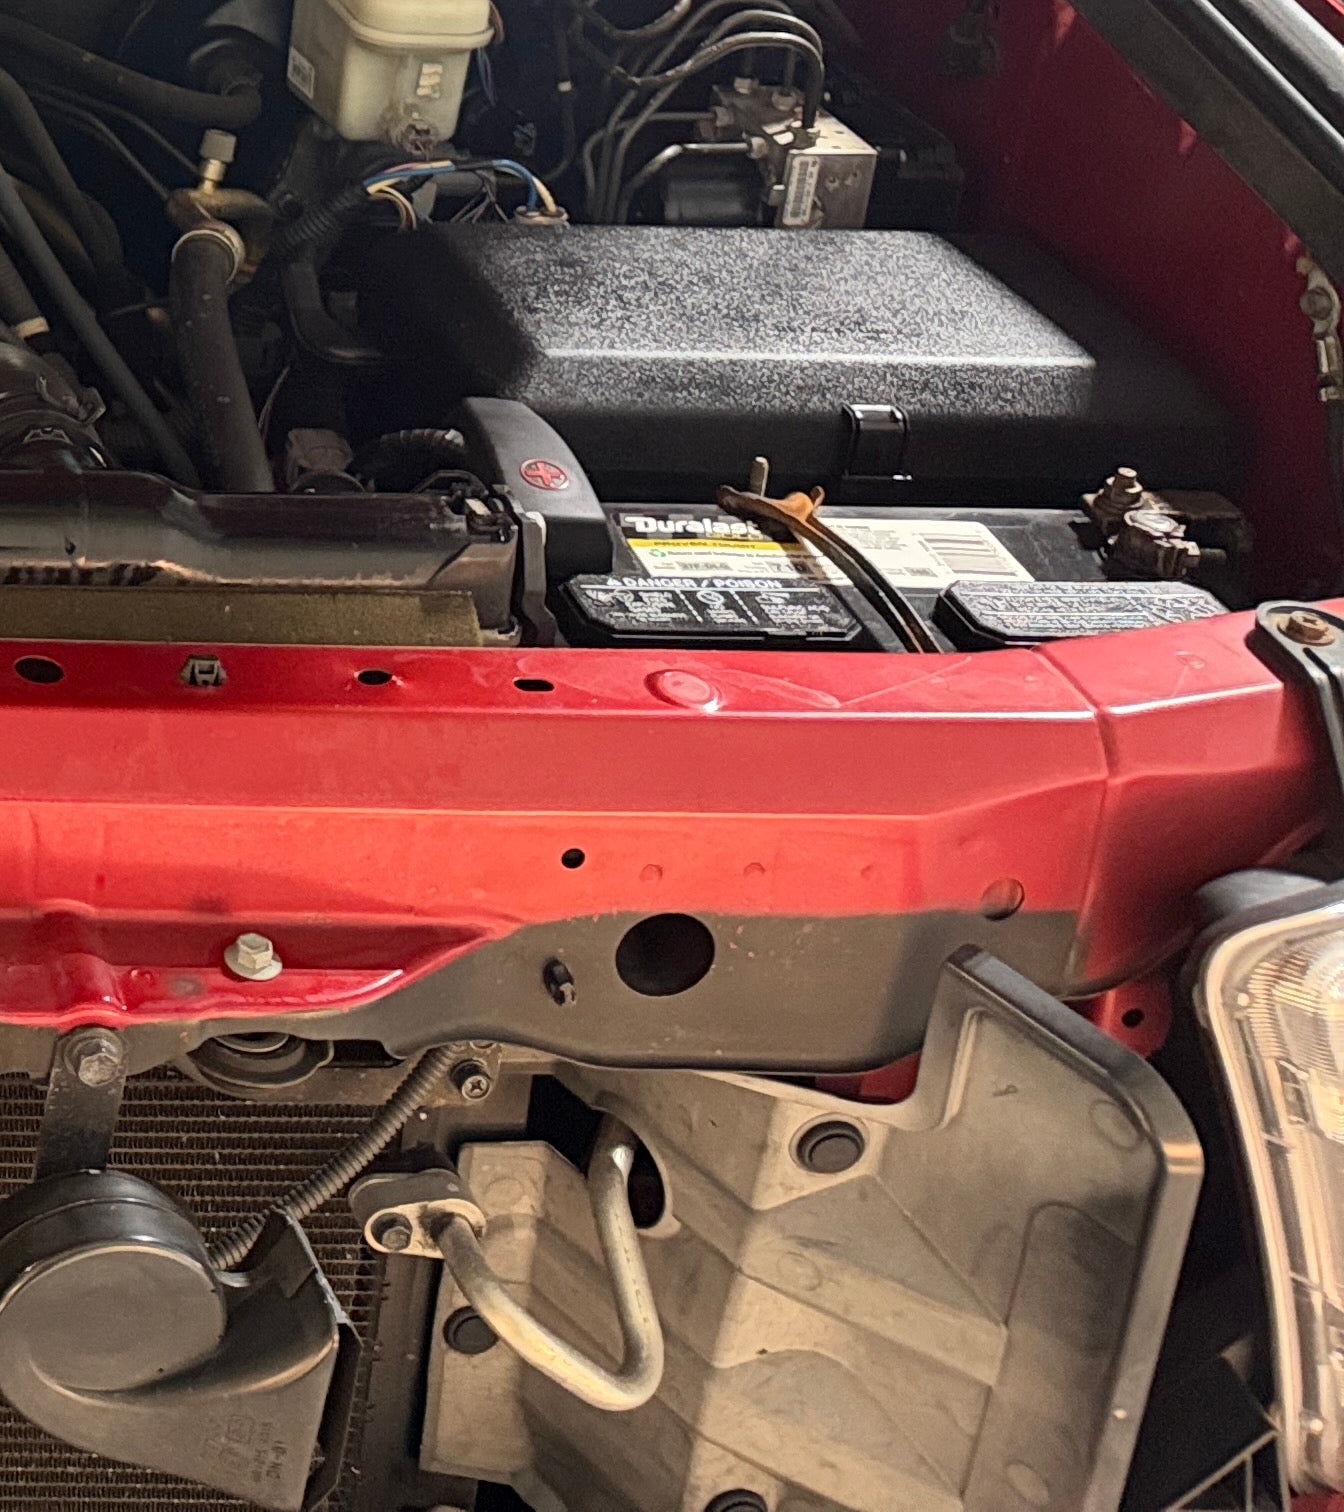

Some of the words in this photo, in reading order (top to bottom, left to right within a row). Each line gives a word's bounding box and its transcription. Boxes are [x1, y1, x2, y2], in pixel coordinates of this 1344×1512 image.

[624, 516, 761, 536] Duralast
[622, 576, 698, 589] DANGER
[713, 577, 783, 590] POISON
